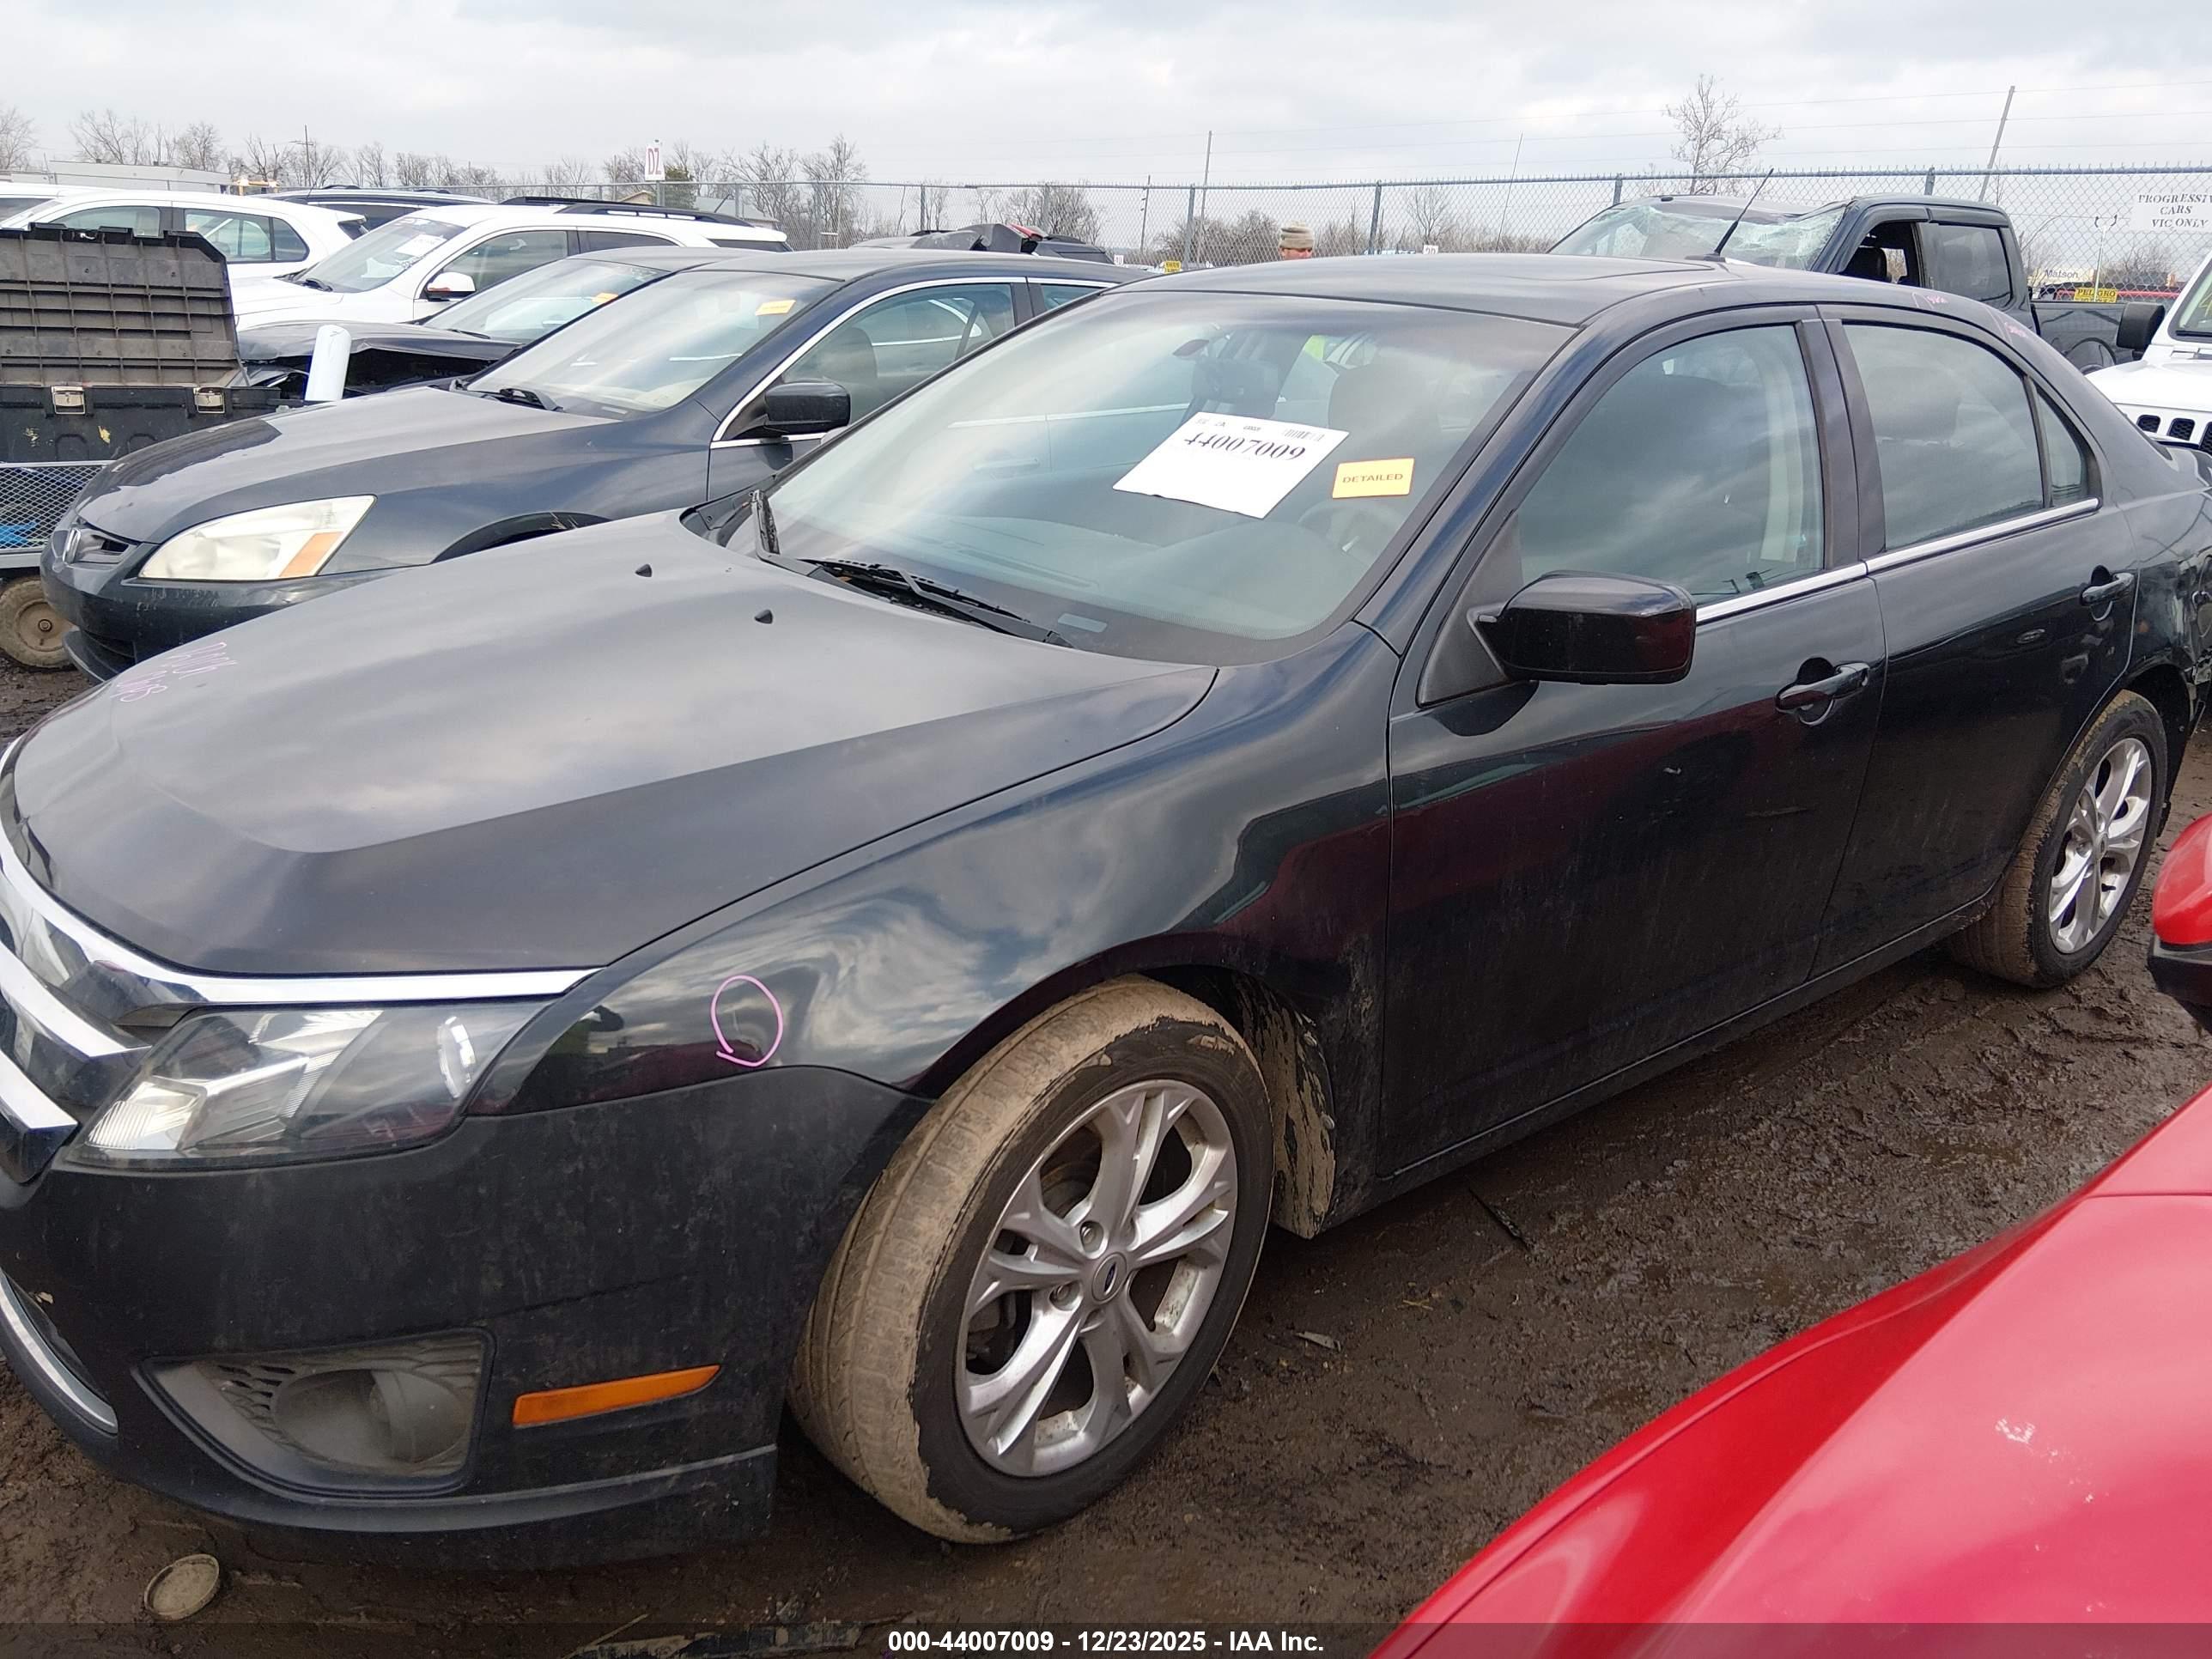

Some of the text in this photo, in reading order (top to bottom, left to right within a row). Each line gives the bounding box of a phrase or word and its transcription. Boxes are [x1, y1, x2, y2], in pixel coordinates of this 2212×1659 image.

[2160, 205, 2192, 215] CARS
[2152, 217, 2209, 228] VIC ONLY
[2045, 269, 2079, 278] Matson
[2078, 289, 2116, 297] PELGRO
[1184, 432, 1306, 460] 44007009
[1342, 473, 1403, 483] DETAILED
